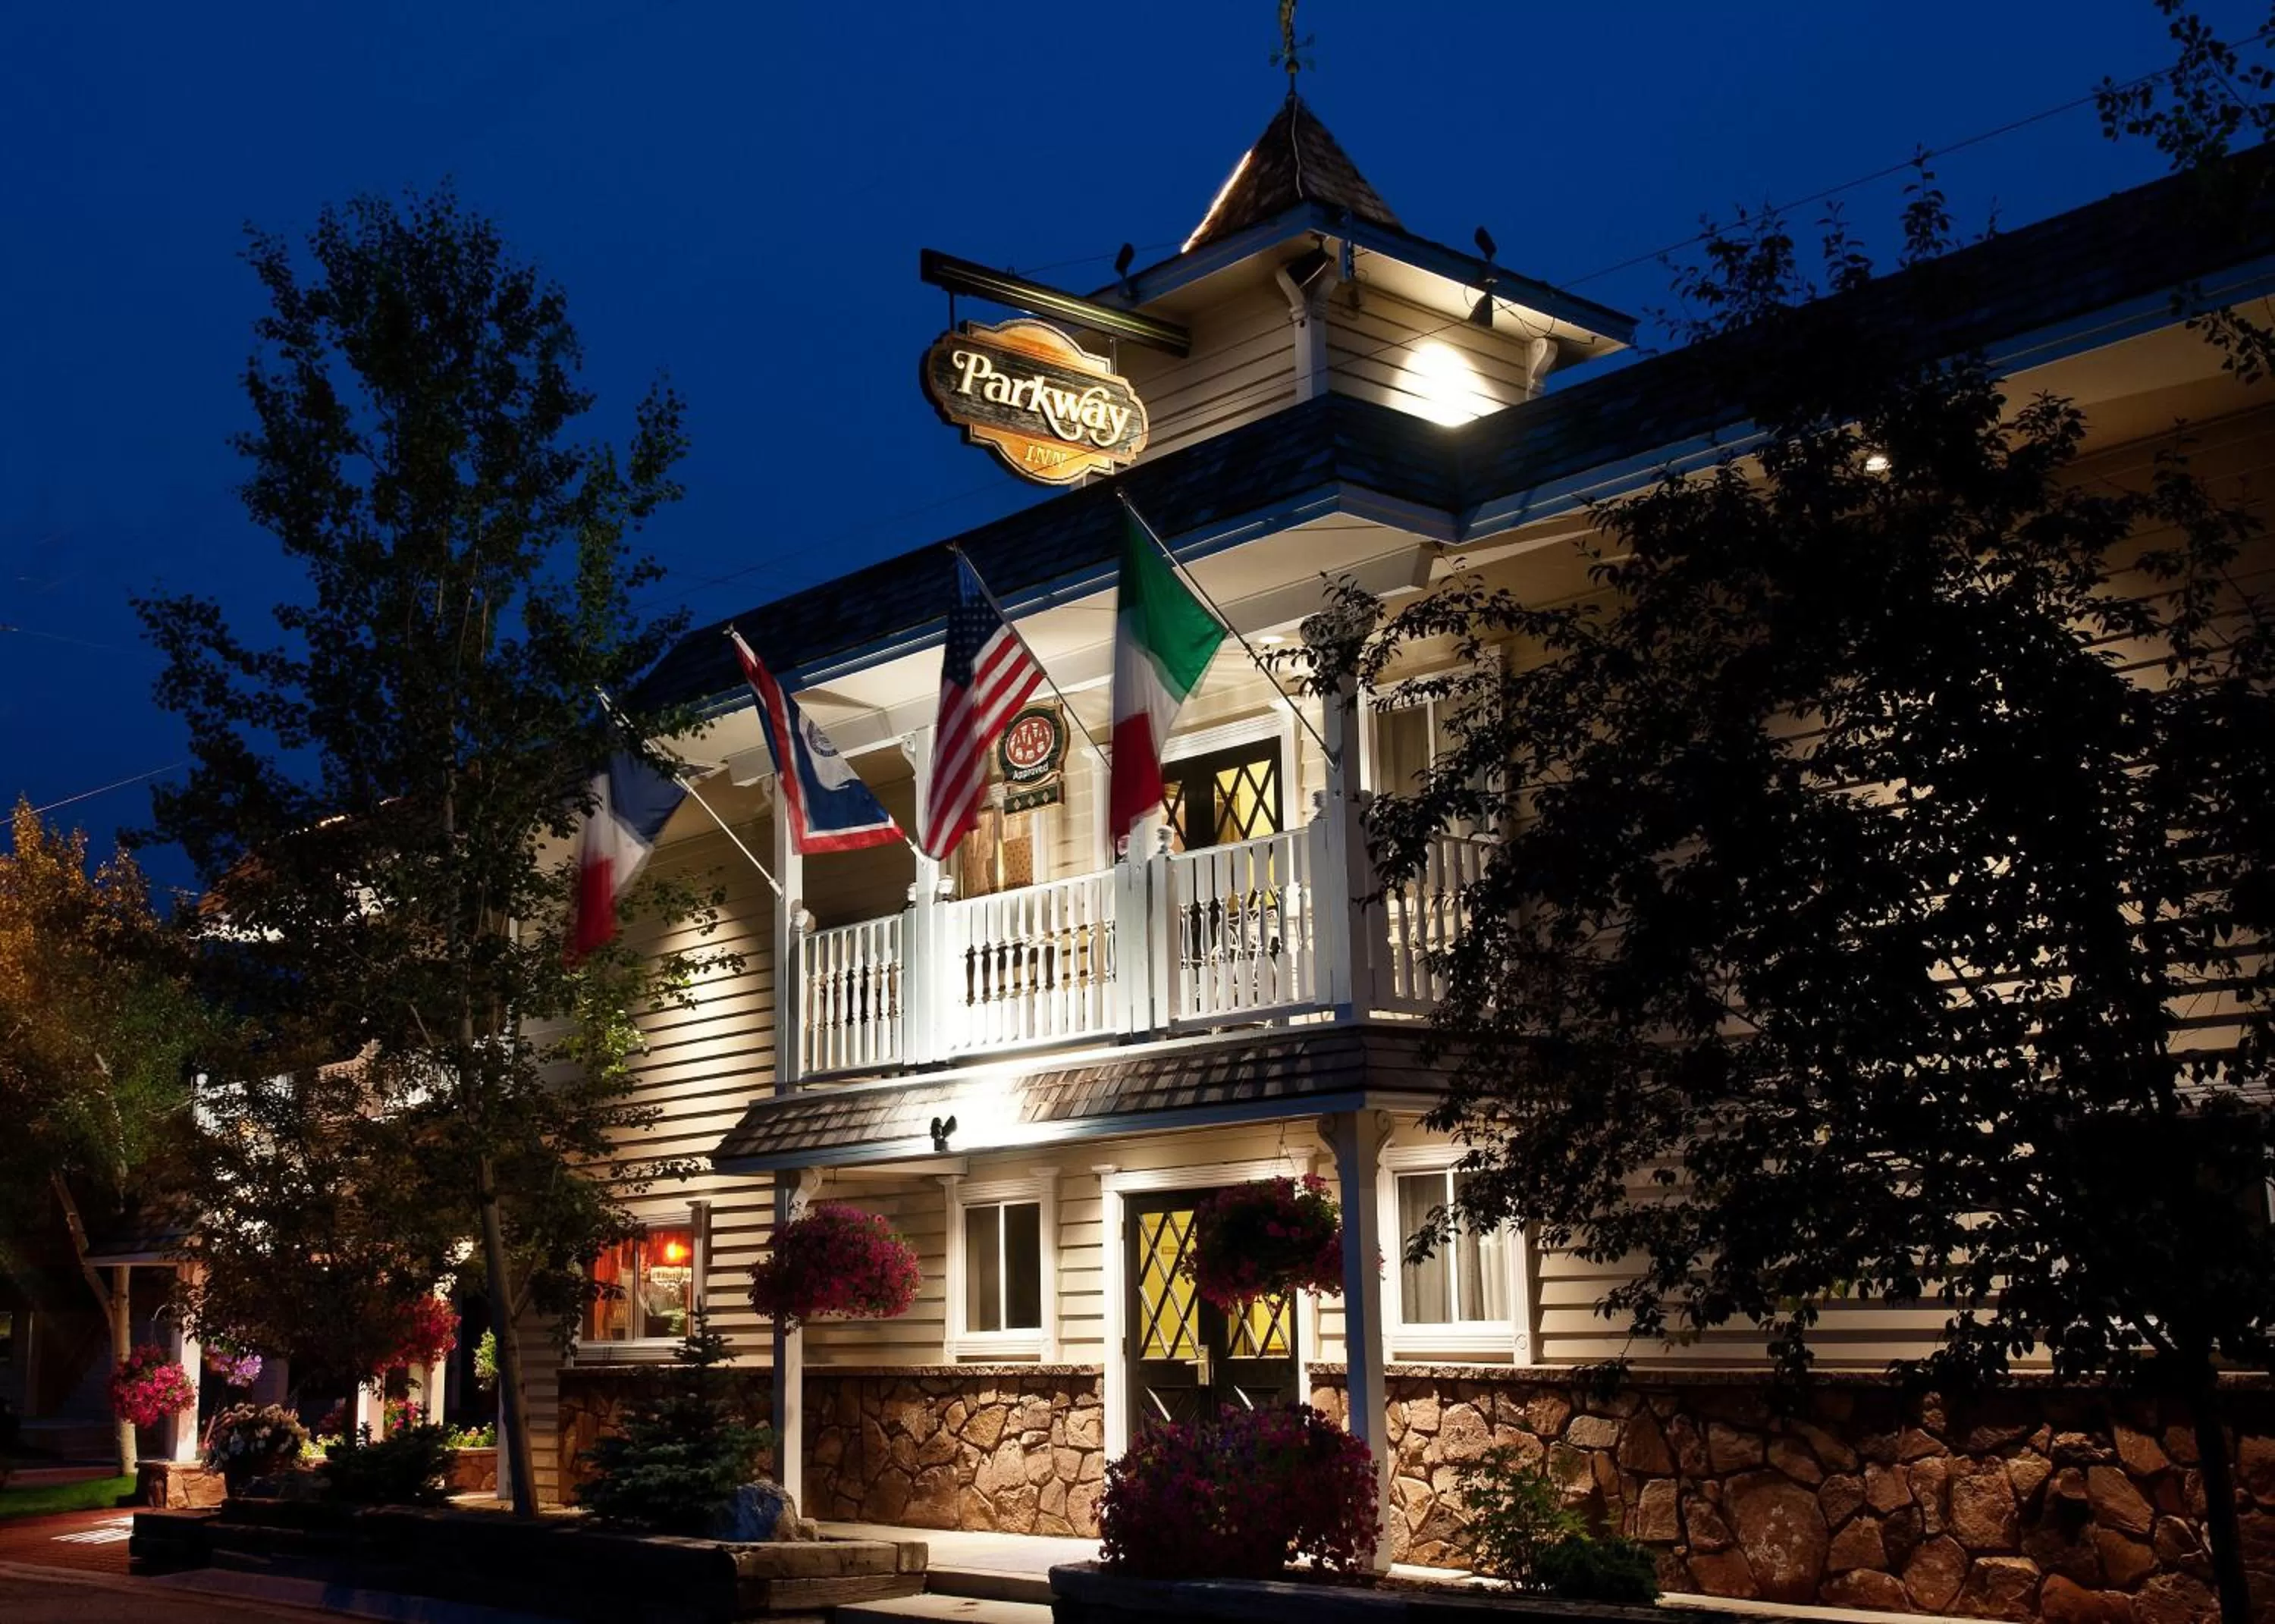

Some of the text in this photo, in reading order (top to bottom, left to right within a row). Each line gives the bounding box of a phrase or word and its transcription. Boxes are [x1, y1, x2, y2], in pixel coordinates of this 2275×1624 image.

[952, 350, 1131, 447] Parkway
[1025, 445, 1067, 469] INN
[1009, 721, 1052, 761] AAA
[1012, 761, 1049, 780] Approved
